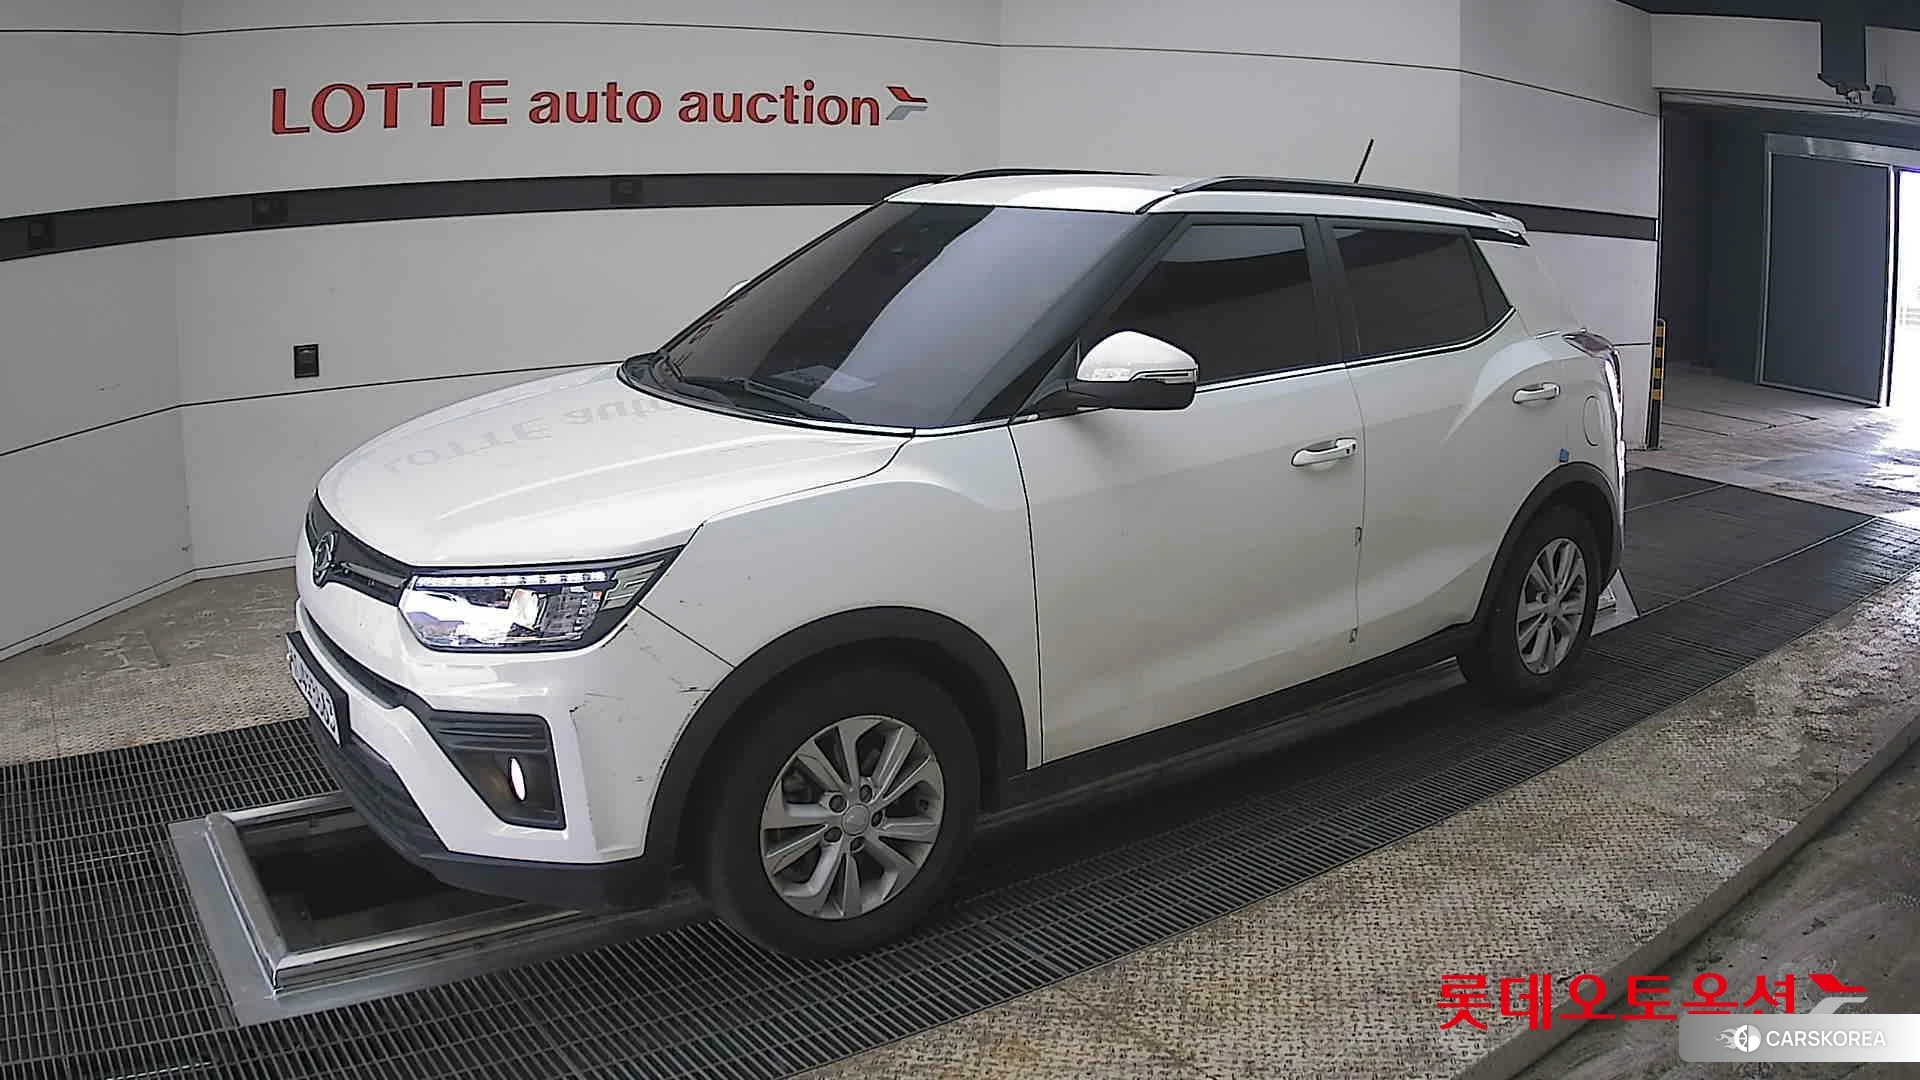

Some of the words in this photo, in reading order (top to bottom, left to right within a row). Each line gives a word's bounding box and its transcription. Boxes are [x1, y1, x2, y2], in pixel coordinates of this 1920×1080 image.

[271, 79, 509, 135] LOTTE
[528, 81, 662, 125] auto
[678, 79, 881, 126] auction
